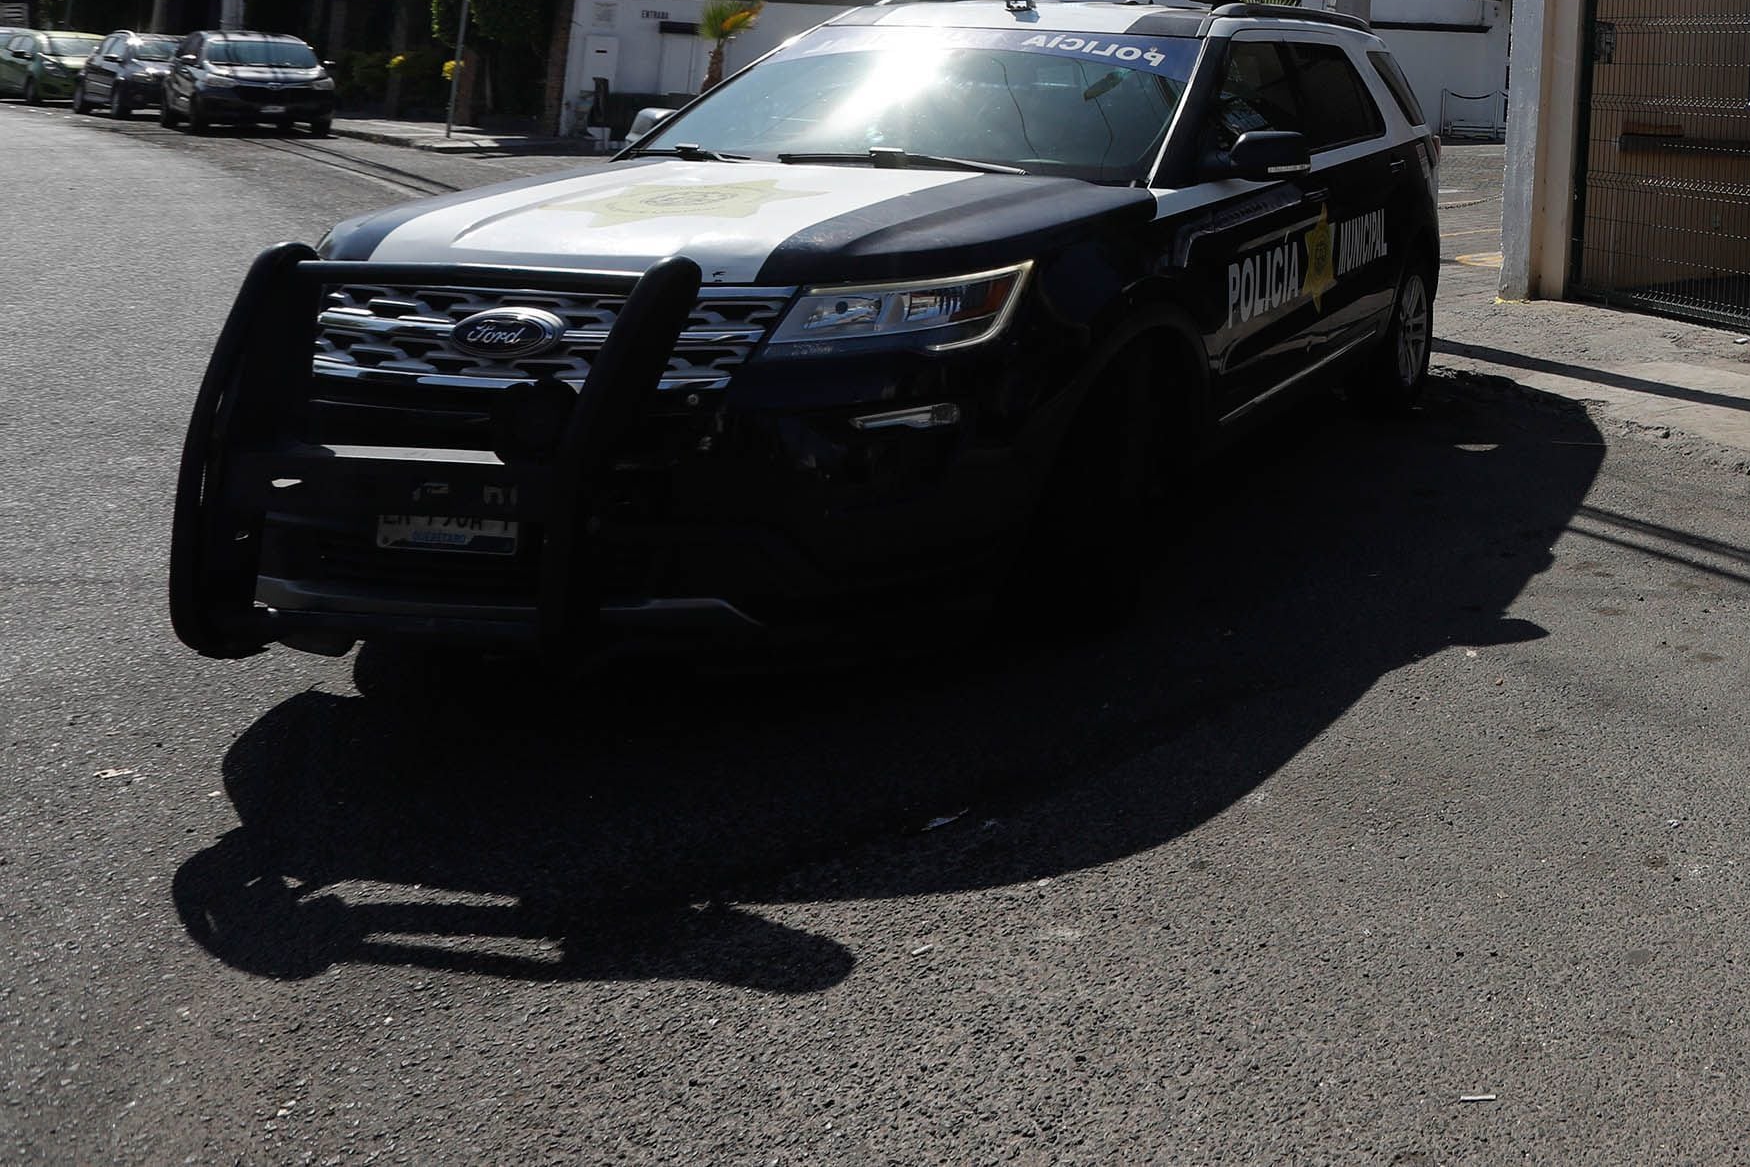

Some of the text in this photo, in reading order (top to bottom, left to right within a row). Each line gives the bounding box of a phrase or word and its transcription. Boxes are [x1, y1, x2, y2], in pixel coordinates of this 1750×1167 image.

[1228, 208, 1388, 330] POLICÍA MUNICIPAL
[466, 324, 527, 344] Ford
